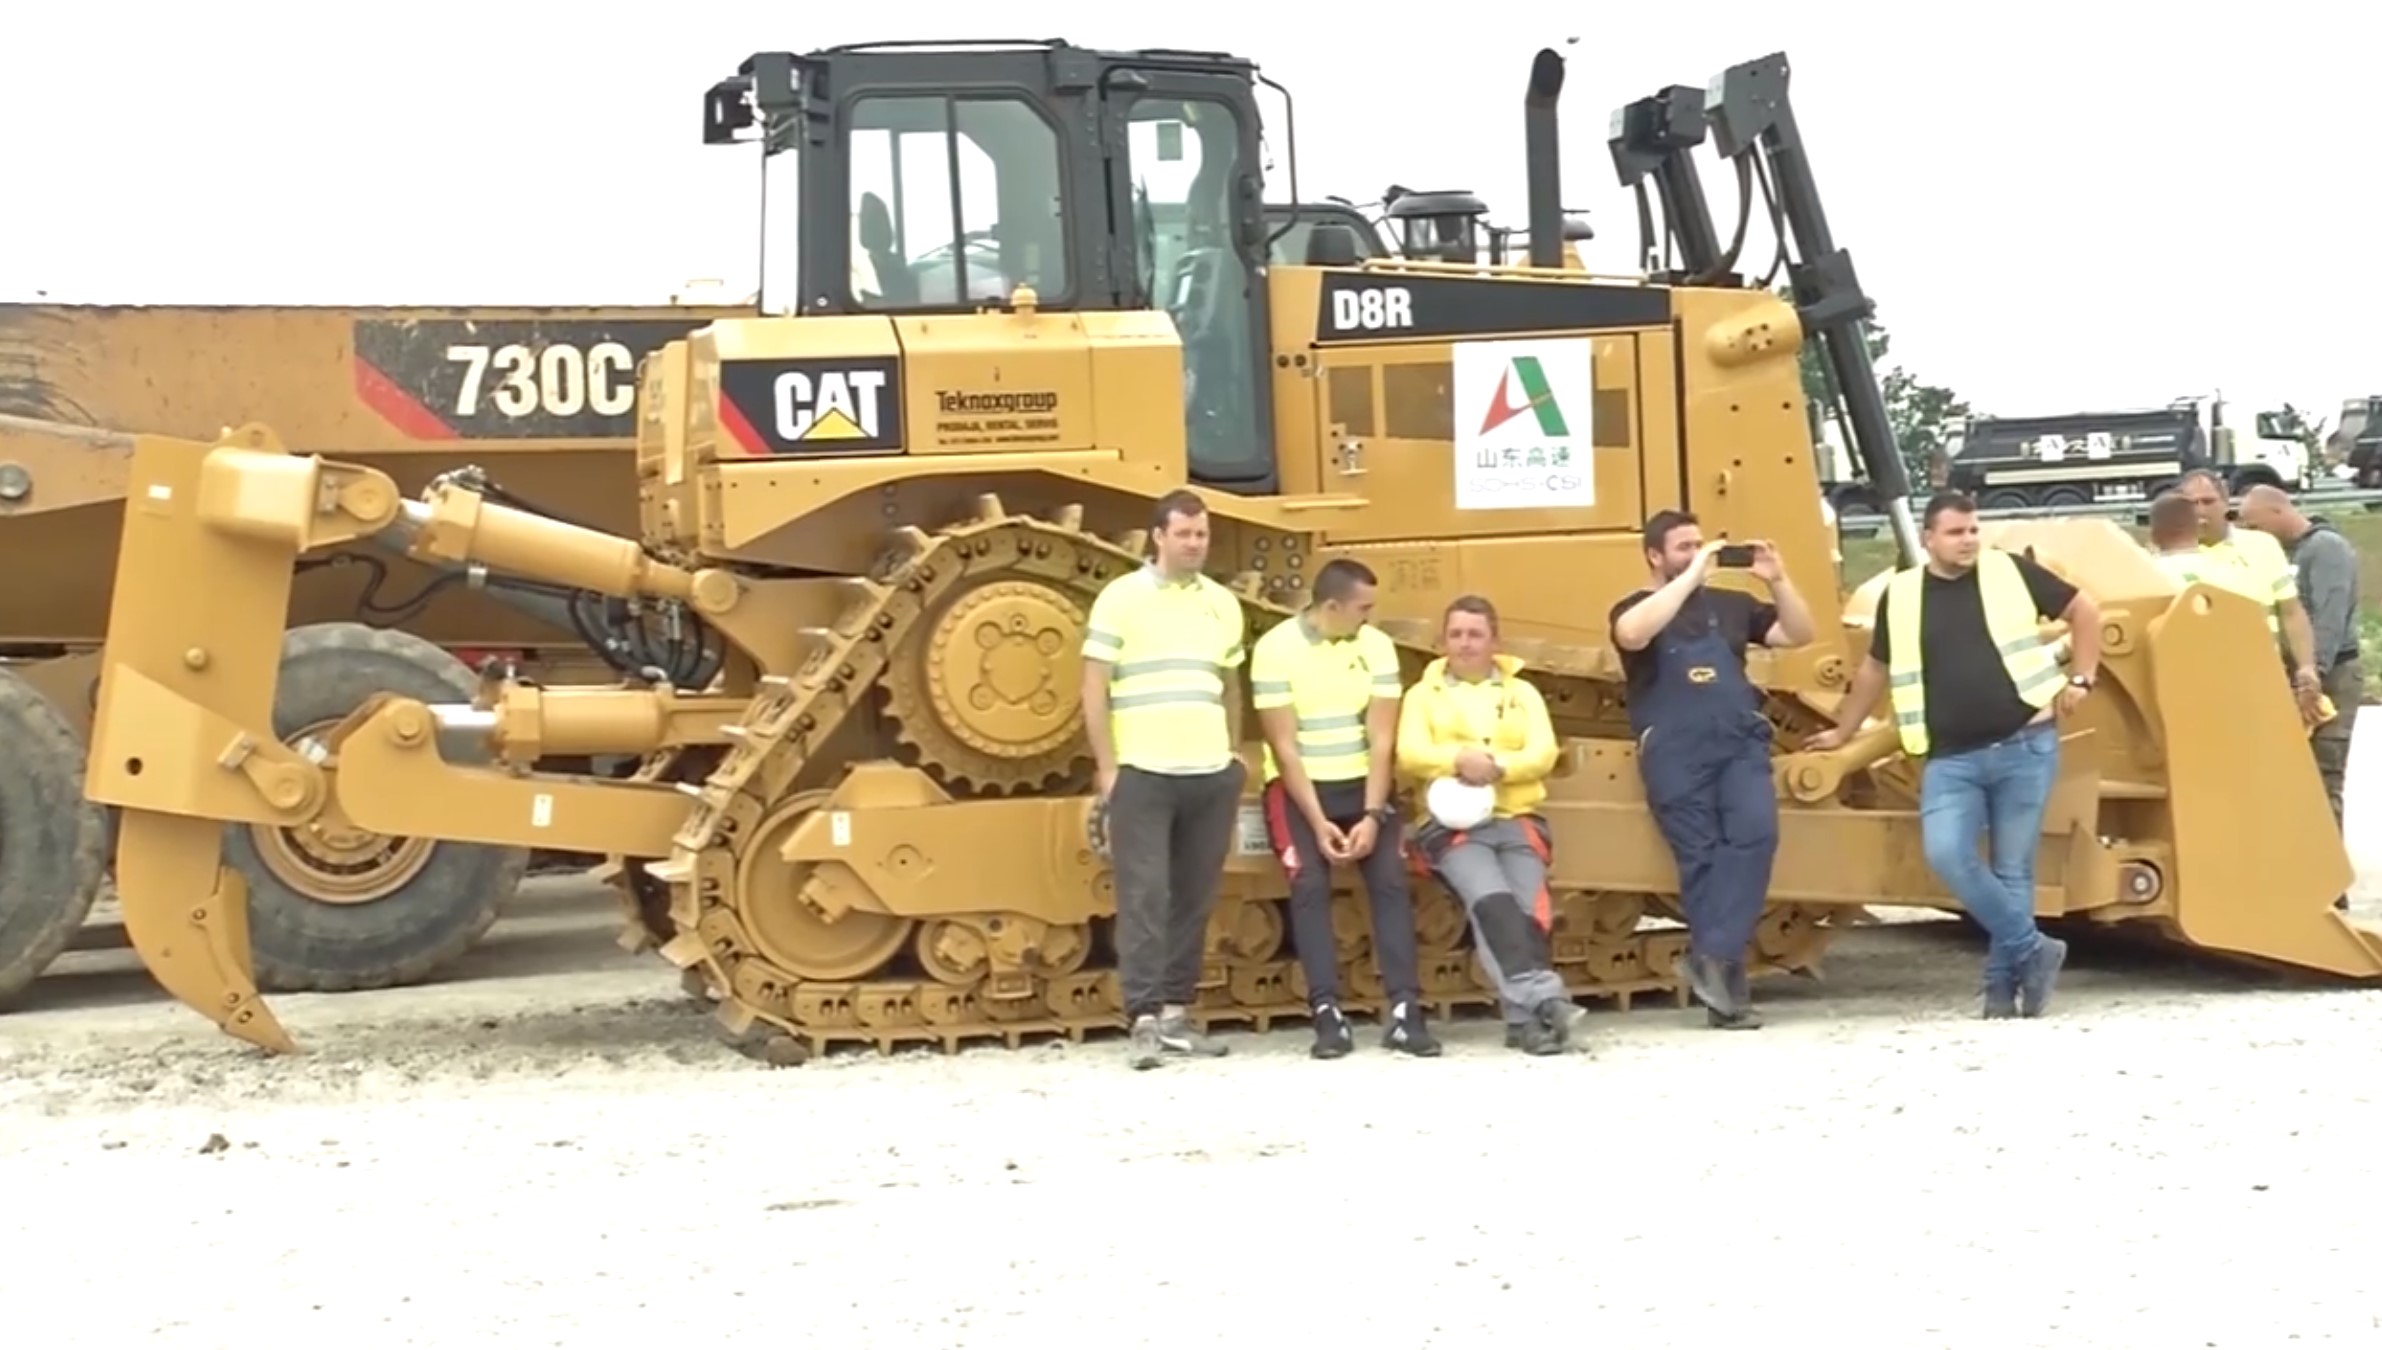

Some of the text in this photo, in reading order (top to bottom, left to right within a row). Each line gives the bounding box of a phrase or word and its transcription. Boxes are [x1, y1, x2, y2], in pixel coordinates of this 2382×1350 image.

[1333, 287, 1413, 330] D8R
[447, 342, 634, 416] 730C
[774, 371, 886, 441] CAT
[934, 390, 1057, 413] Teknoxgroup
